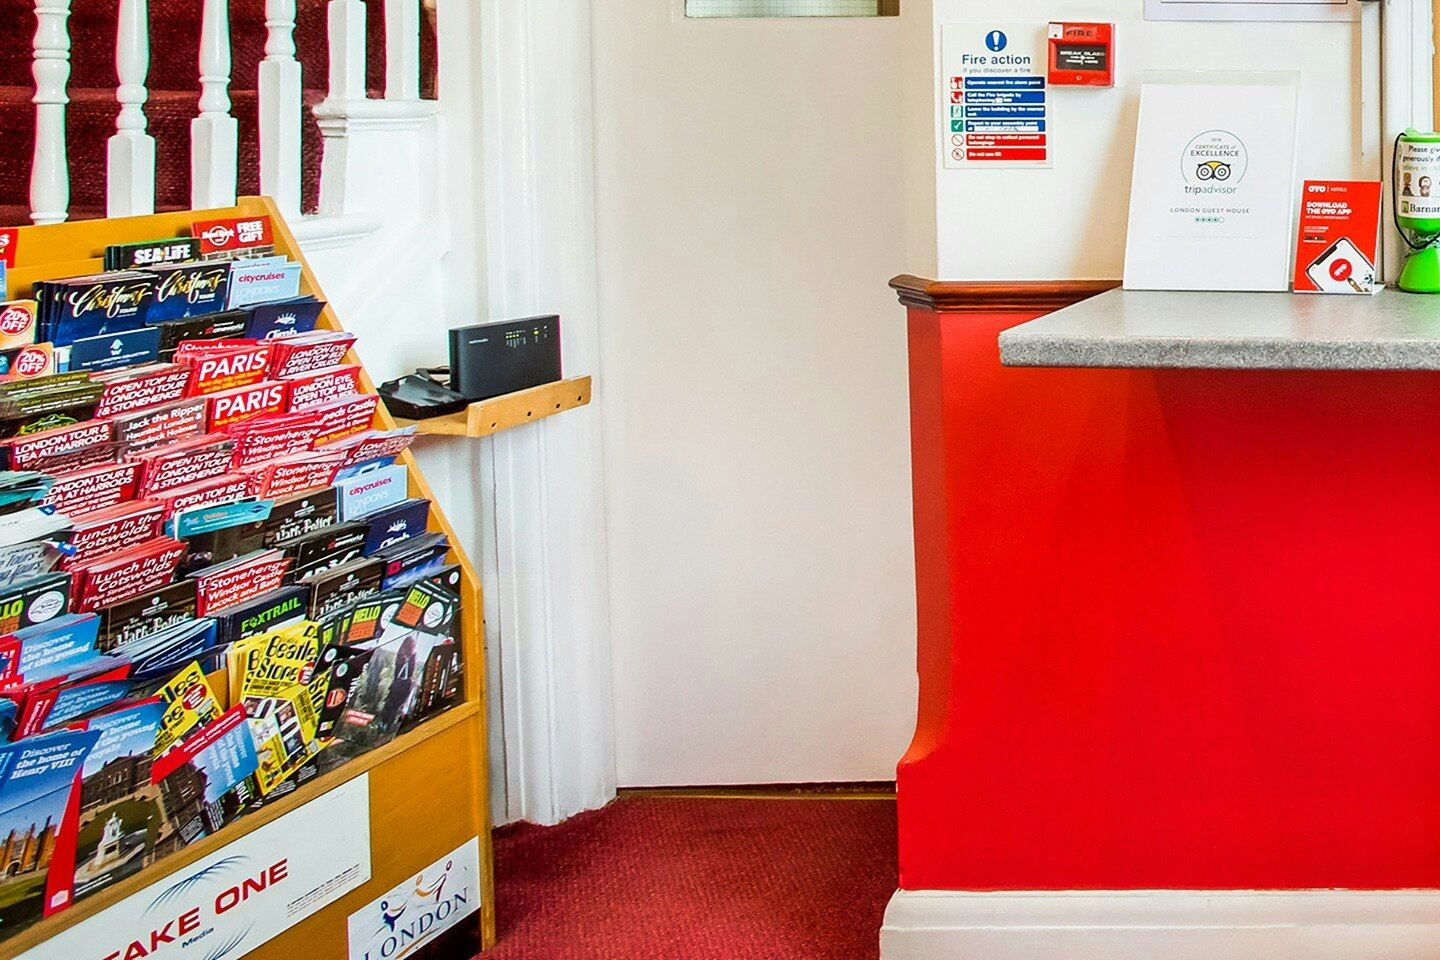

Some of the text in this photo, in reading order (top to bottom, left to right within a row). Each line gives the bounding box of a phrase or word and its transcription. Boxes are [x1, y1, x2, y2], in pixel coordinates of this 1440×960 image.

[962, 54, 1030, 64] Fire action
[1185, 185, 1236, 195] tripadvisor
[237, 221, 262, 231] FREE
[239, 232, 262, 242] GIFT
[135, 247, 161, 264] SEA
[238, 272, 285, 283] citycruises
[1, 318, 26, 331] OFF
[5, 309, 29, 324] 20%
[199, 350, 268, 382] PARIS
[106, 380, 186, 405] LONDON TOUR
[109, 371, 190, 395] OPEN TOP BUS
[110, 390, 183, 415] STONEHENGE
[16, 425, 110, 455] LONDON TOUR &
[16, 433, 110, 464] TEA AT HARRODS
[73, 512, 162, 544] Lunch in the
[76, 524, 151, 552] Cotswolds
[209, 569, 284, 601] Windsor Castle
[210, 560, 290, 590] Stonehenge
[407, 589, 430, 608] HELLO
[257, 658, 298, 681] Store
[16, 747, 86, 769] the home of
[20, 743, 71, 759] Discover
[11, 757, 76, 780] Henry VIII
[215, 858, 288, 915] ONE
[182, 927, 214, 948] Media
